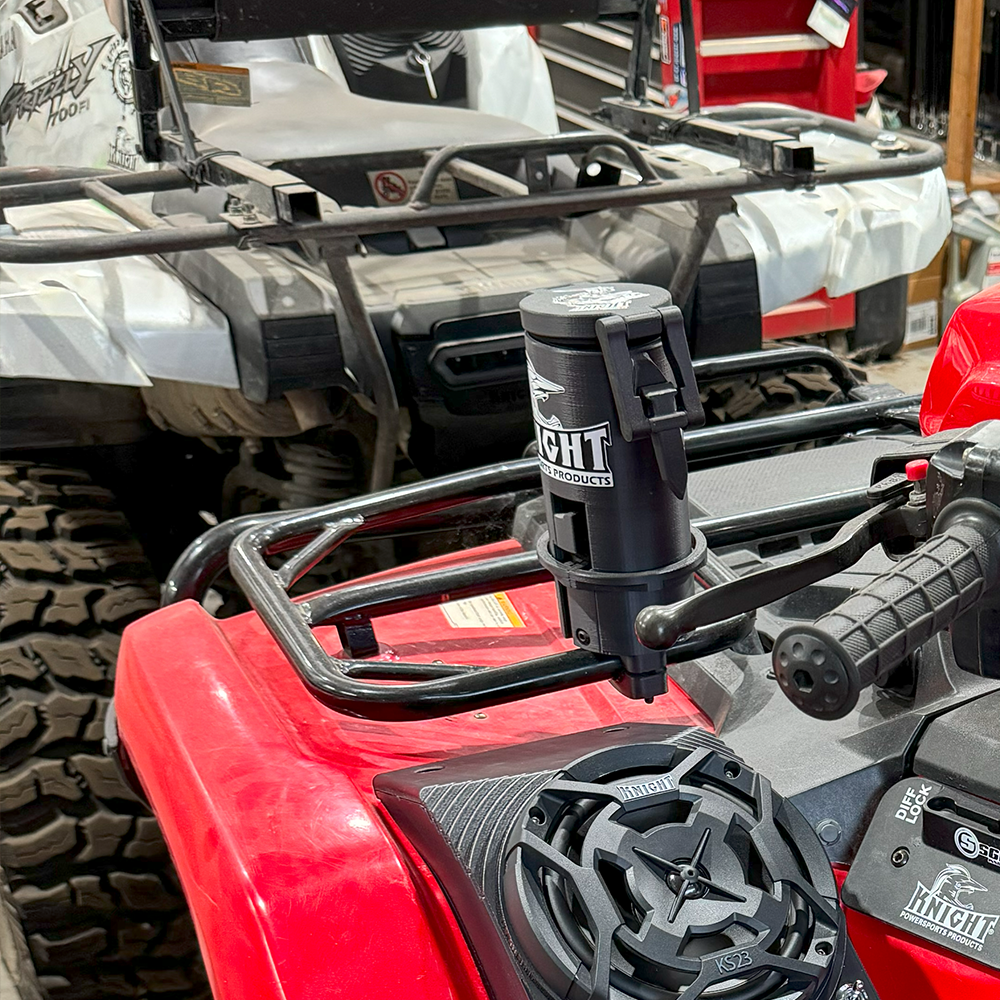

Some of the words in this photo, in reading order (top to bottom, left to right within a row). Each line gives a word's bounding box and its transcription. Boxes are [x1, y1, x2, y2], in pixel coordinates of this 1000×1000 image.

[537, 425, 609, 473] IGHT
[553, 467, 611, 486] PRODUCTS
[616, 774, 677, 802] KNIGHT
[894, 786, 916, 821] DIFF
[905, 783, 933, 825] LOCK
[900, 910, 948, 937] POWERSPORTS
[947, 928, 983, 951] PRODUCTS
[904, 883, 999, 943] KNIGHT
[714, 950, 754, 975] KS23
